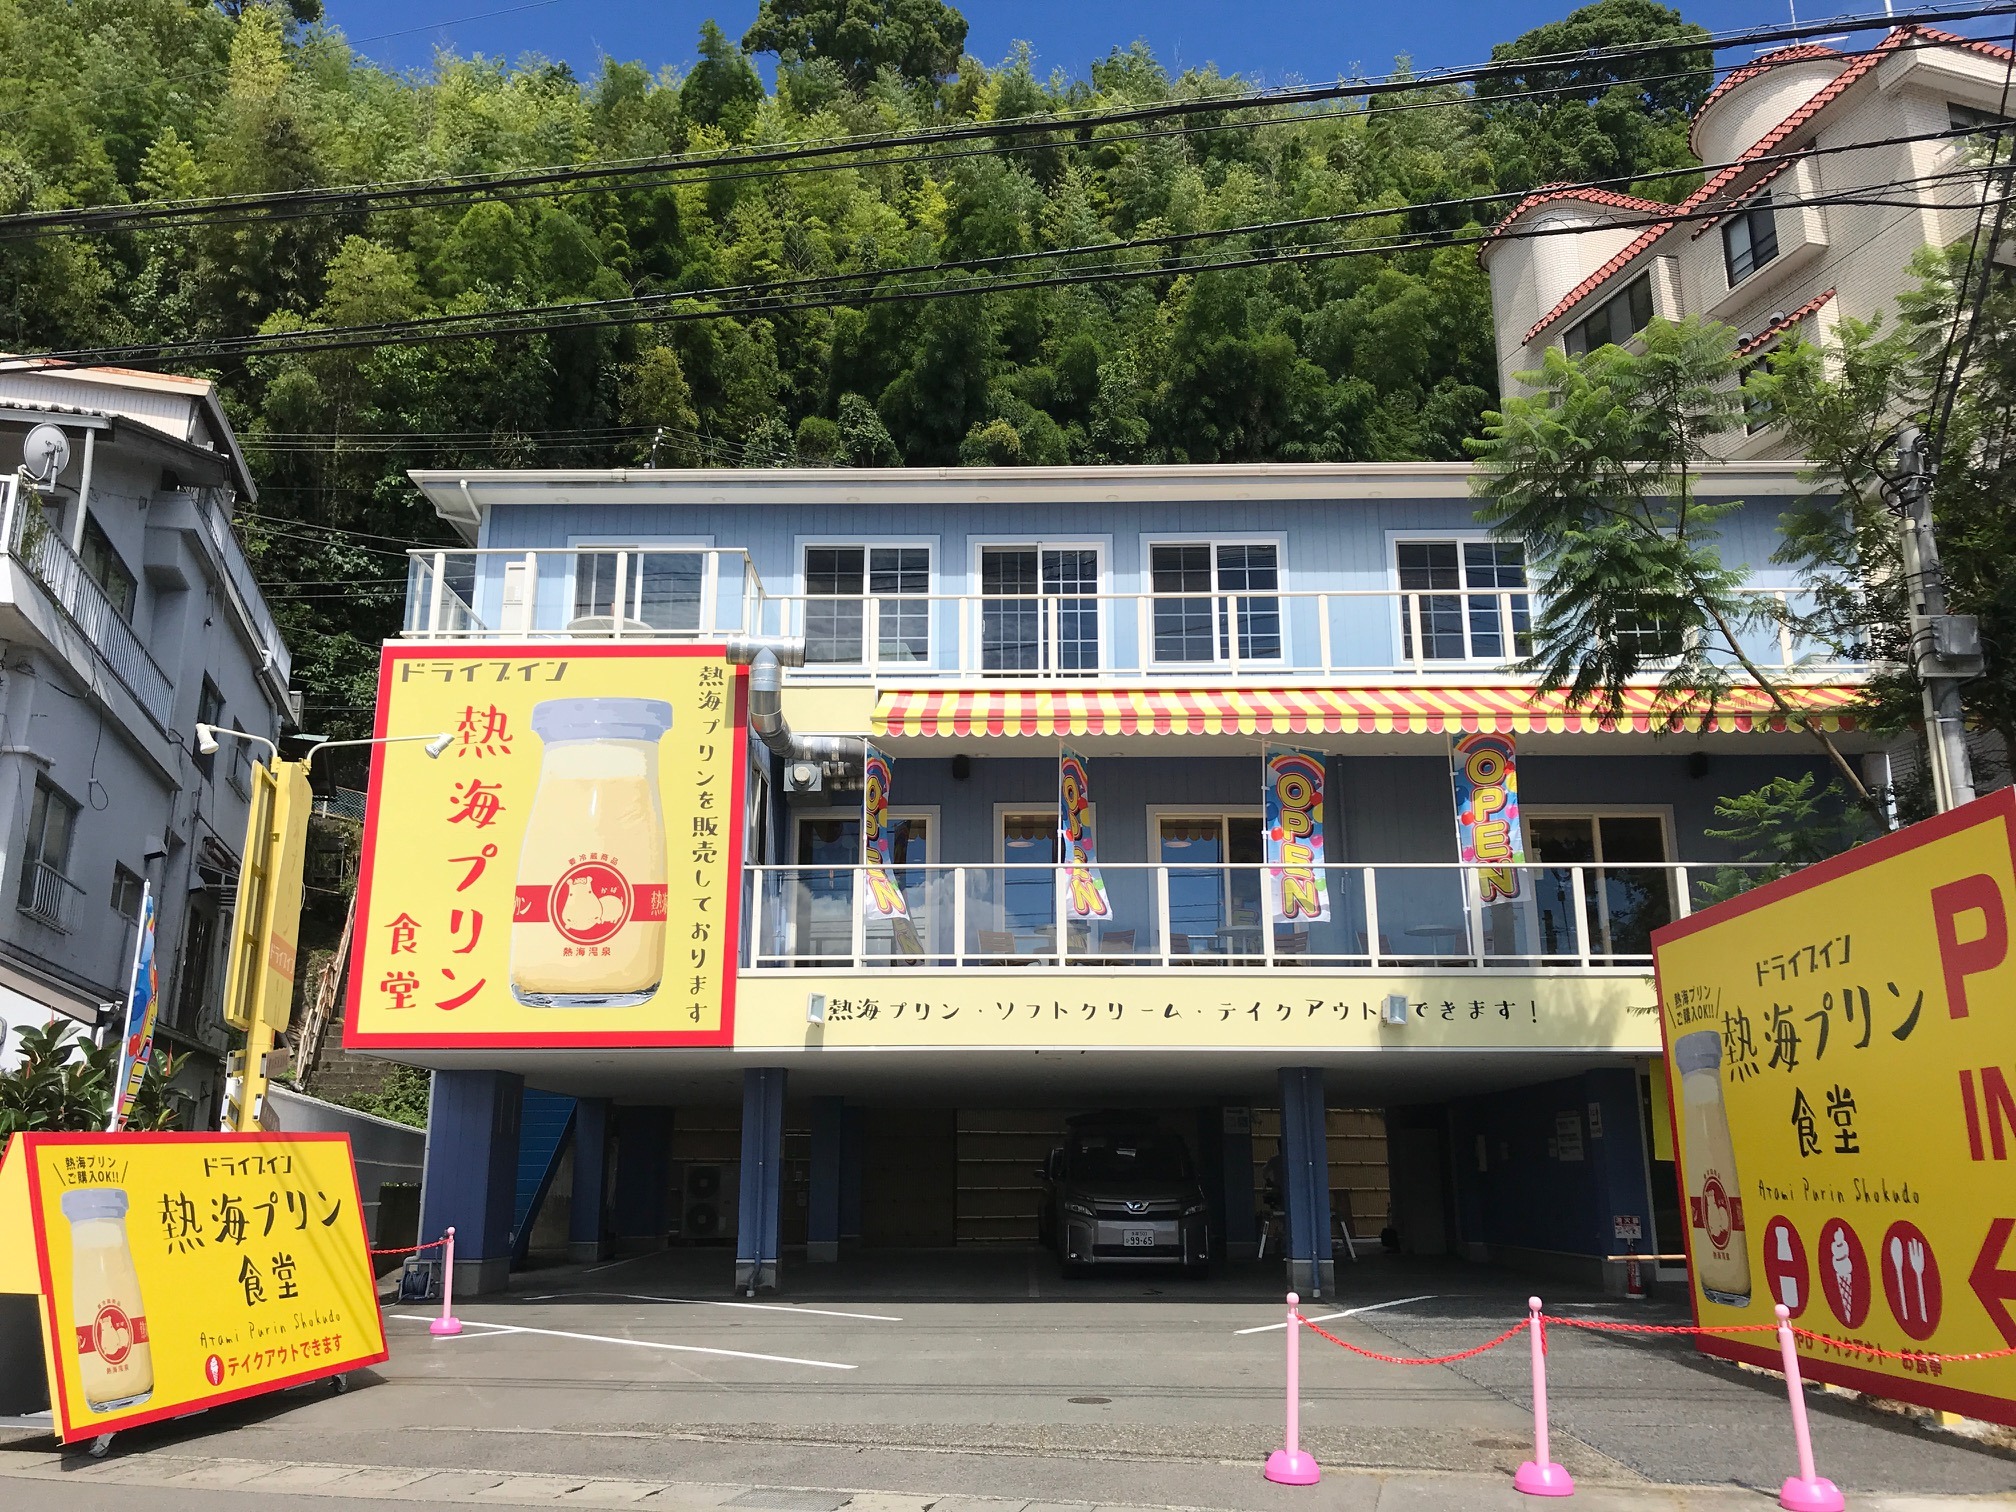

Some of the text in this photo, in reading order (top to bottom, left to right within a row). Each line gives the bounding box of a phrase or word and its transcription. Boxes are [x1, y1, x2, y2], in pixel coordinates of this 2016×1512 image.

[401, 661, 569, 684] ドライブイン
[685, 665, 725, 1023] 熱海プリンを販売しております
[1276, 770, 1324, 922] OPEN
[1464, 747, 1522, 906] OPEN
[434, 703, 514, 1012] 熱海プリン
[379, 912, 423, 1011] 食堂
[1755, 934, 1851, 987] ドライブイン
[1930, 872, 2009, 1020] P
[1722, 981, 1924, 1083] 熱海プリン
[1790, 1083, 1860, 1159] 食堂
[65, 1155, 117, 1171] 熱海プリン
[67, 1171, 119, 1185] ご購入OK!!
[204, 1155, 292, 1178] ドライブイン
[1803, 1177, 1845, 1204] Purin
[1853, 1177, 1920, 1204] Shokudo
[157, 1189, 343, 1255] 熱海プリン
[237, 1251, 300, 1307] 食堂
[200, 1309, 341, 1349] Atami Purin Shokudo
[227, 1333, 343, 1377] テイクアウトできます
